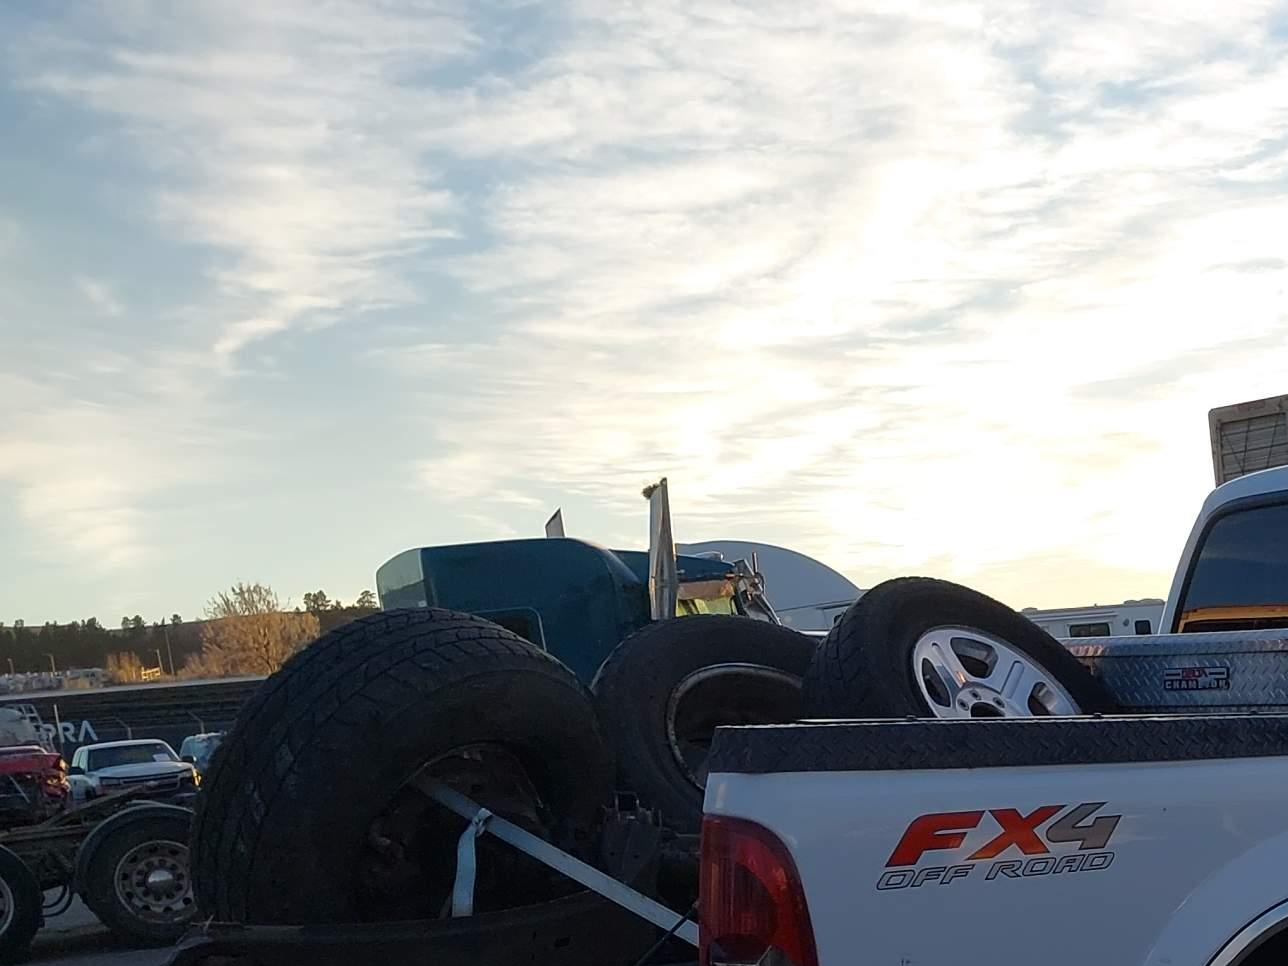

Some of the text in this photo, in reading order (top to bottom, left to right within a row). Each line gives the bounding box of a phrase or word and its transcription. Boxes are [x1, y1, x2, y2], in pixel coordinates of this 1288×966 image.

[1164, 679, 1231, 690] CHAMON
[885, 801, 1122, 868] FX4
[876, 851, 1116, 891] OFF ROAD
